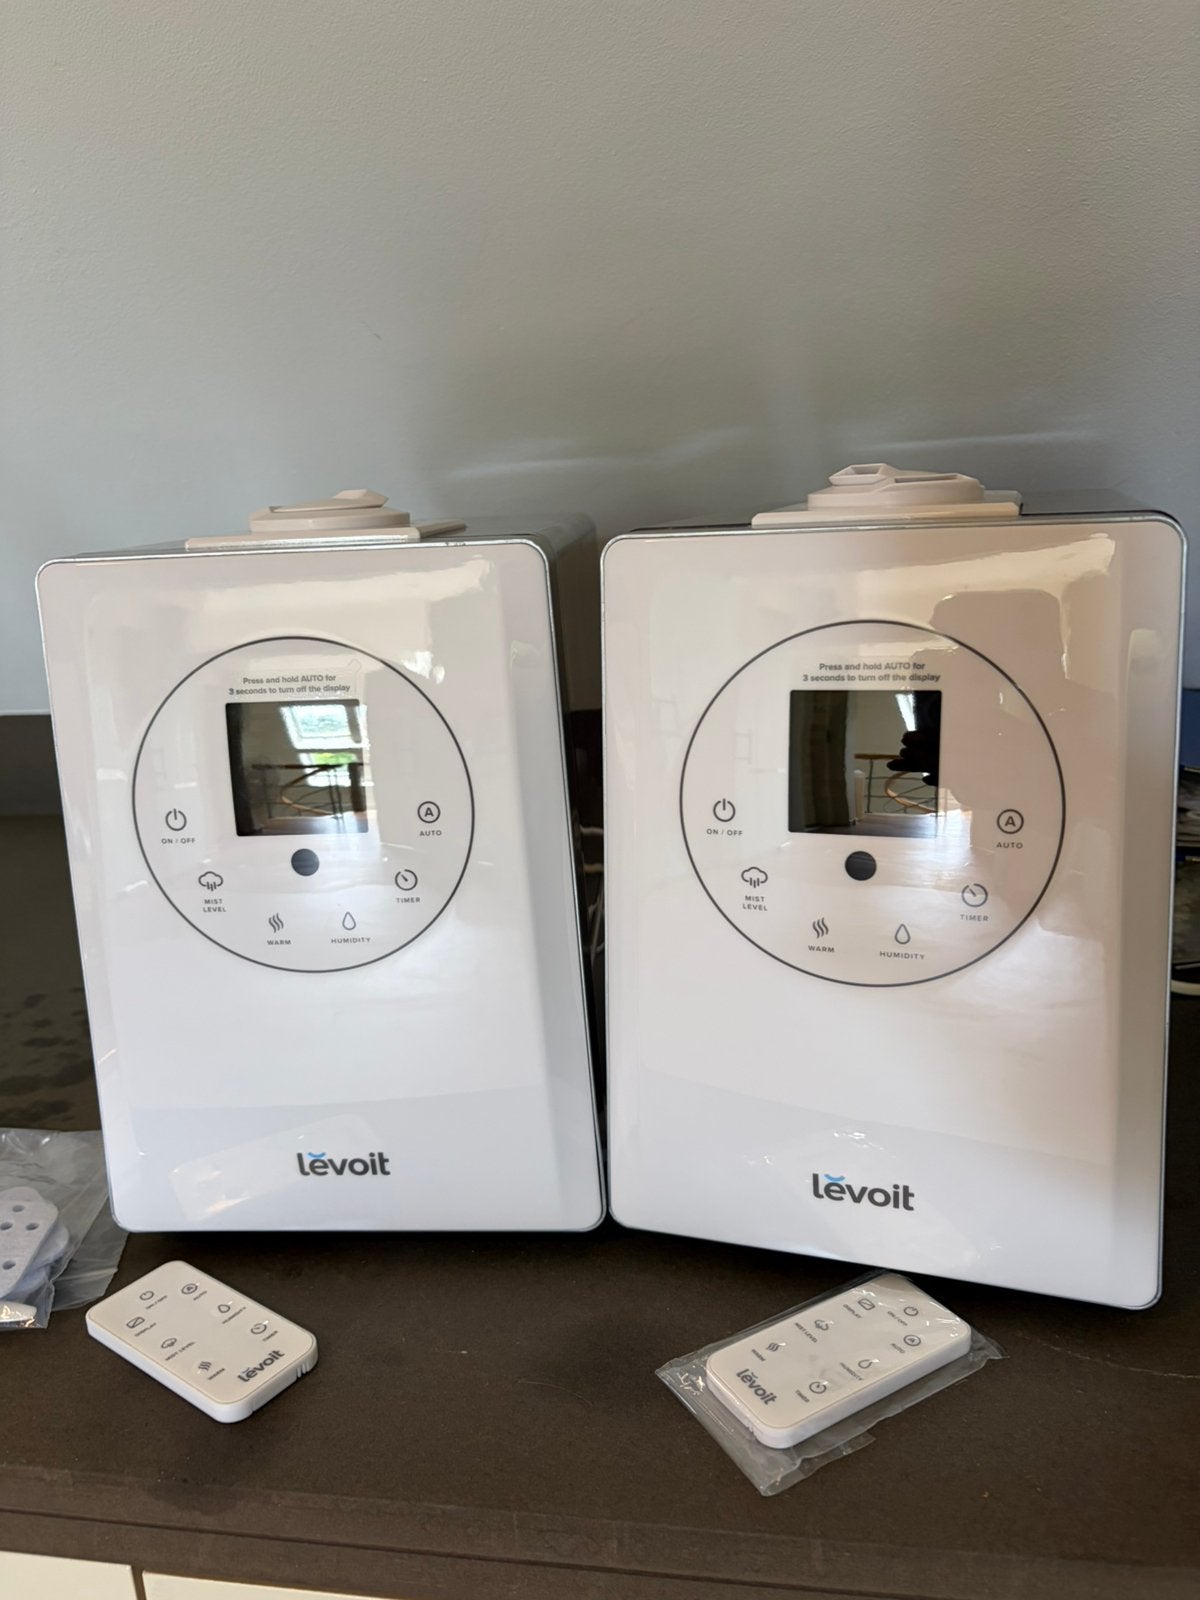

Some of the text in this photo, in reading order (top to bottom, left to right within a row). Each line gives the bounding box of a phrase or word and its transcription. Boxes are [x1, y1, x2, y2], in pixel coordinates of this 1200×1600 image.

[819, 662, 926, 671] Press and hold AUTO for
[242, 677, 264, 685] Press
[265, 676, 280, 684] and
[281, 675, 299, 683] hold
[301, 674, 324, 682] AUTO
[802, 674, 809, 682] 3
[810, 673, 845, 682] seconds
[878, 673, 891, 681] off
[892, 673, 907, 681] the
[908, 673, 941, 683] display
[228, 687, 235, 696] 3
[235, 686, 267, 695] seconds
[268, 686, 277, 694] to
[296, 685, 307, 693] off
[308, 684, 322, 692] the
[322, 683, 351, 693] display
[419, 829, 442, 837] AUTO
[706, 828, 720, 836] ON
[726, 829, 743, 837] OFF
[161, 837, 174, 845] ON
[996, 841, 1024, 849] AUTO
[396, 896, 421, 904] TIMER
[744, 895, 766, 903] MIST
[742, 903, 769, 912] LEVEL
[959, 914, 989, 922] TIMER
[267, 938, 292, 946] WARM
[331, 936, 372, 944] HUMIDITY
[807, 944, 835, 953] WARM
[879, 951, 926, 960] HUMIDITY
